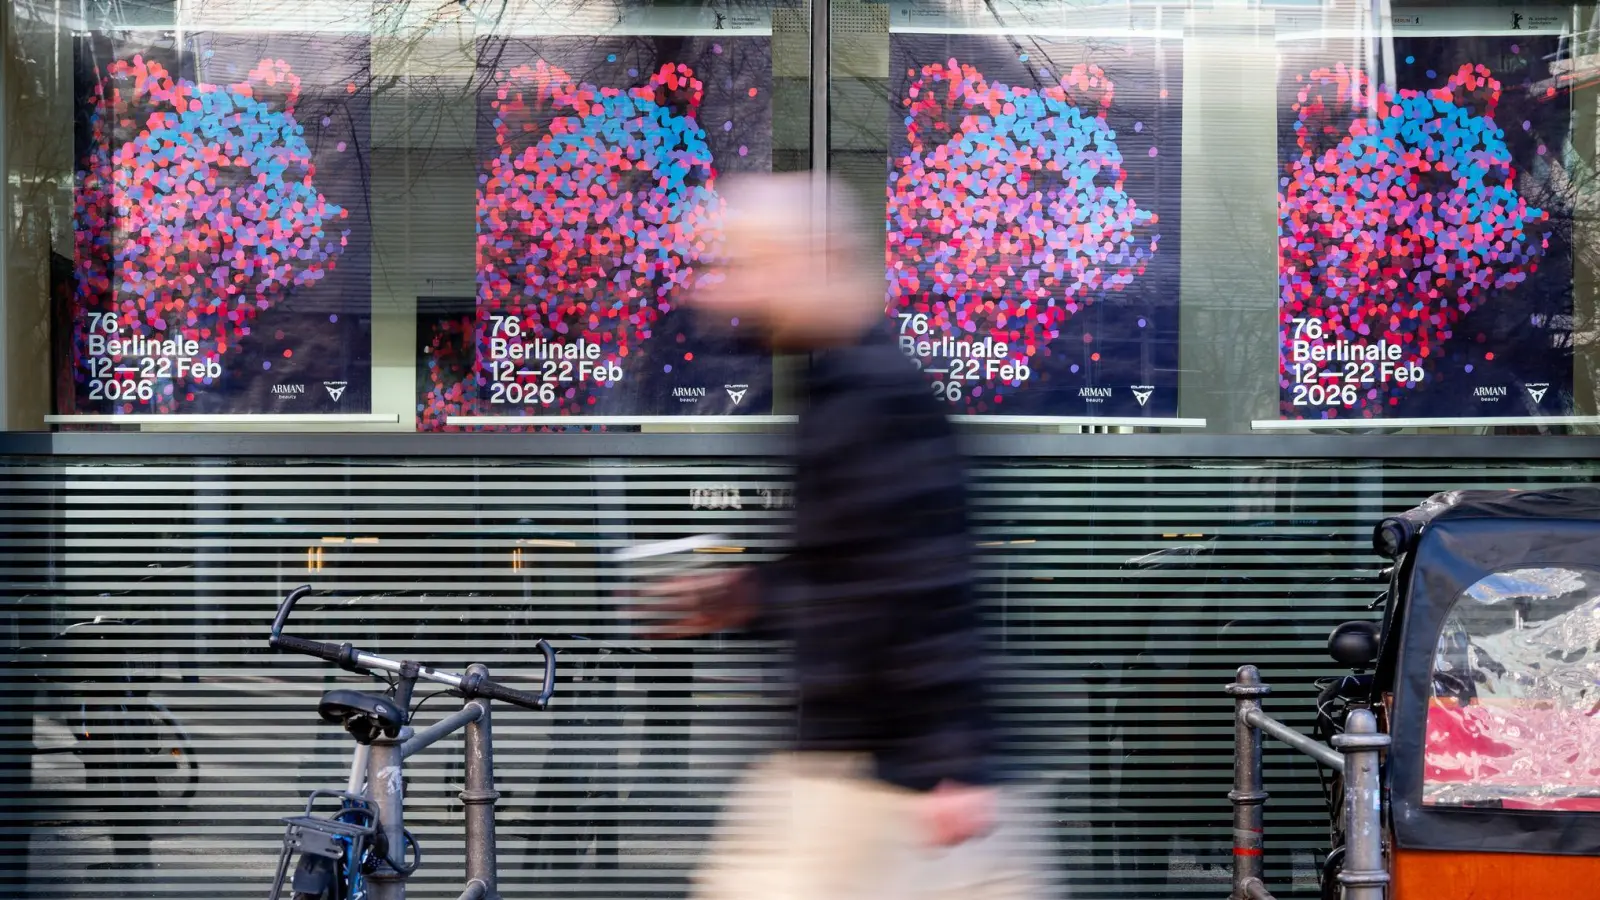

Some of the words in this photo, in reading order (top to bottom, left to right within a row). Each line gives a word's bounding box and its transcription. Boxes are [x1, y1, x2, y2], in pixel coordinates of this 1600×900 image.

[87, 312, 125, 334] 76.
[489, 315, 527, 337] 76.
[898, 313, 935, 335] 76.
[1292, 317, 1329, 340] 76.
[88, 334, 200, 356] Berlinale
[490, 338, 601, 360] Berlinale
[899, 335, 1009, 358] Berlinale
[1293, 339, 1403, 361] Berlinale
[177, 357, 222, 379] Feb
[579, 360, 624, 382] Feb
[985, 358, 1031, 380] Feb
[1380, 361, 1425, 383] Feb
[88, 379, 154, 400] 2026
[270, 384, 305, 394] ARMANI
[490, 382, 556, 404] 2026
[671, 387, 706, 397] ARMANI
[931, 380, 962, 402] 26
[1078, 387, 1112, 397] ARMANI
[1293, 384, 1358, 406] 2026
[1473, 386, 1507, 396] ARMANI
